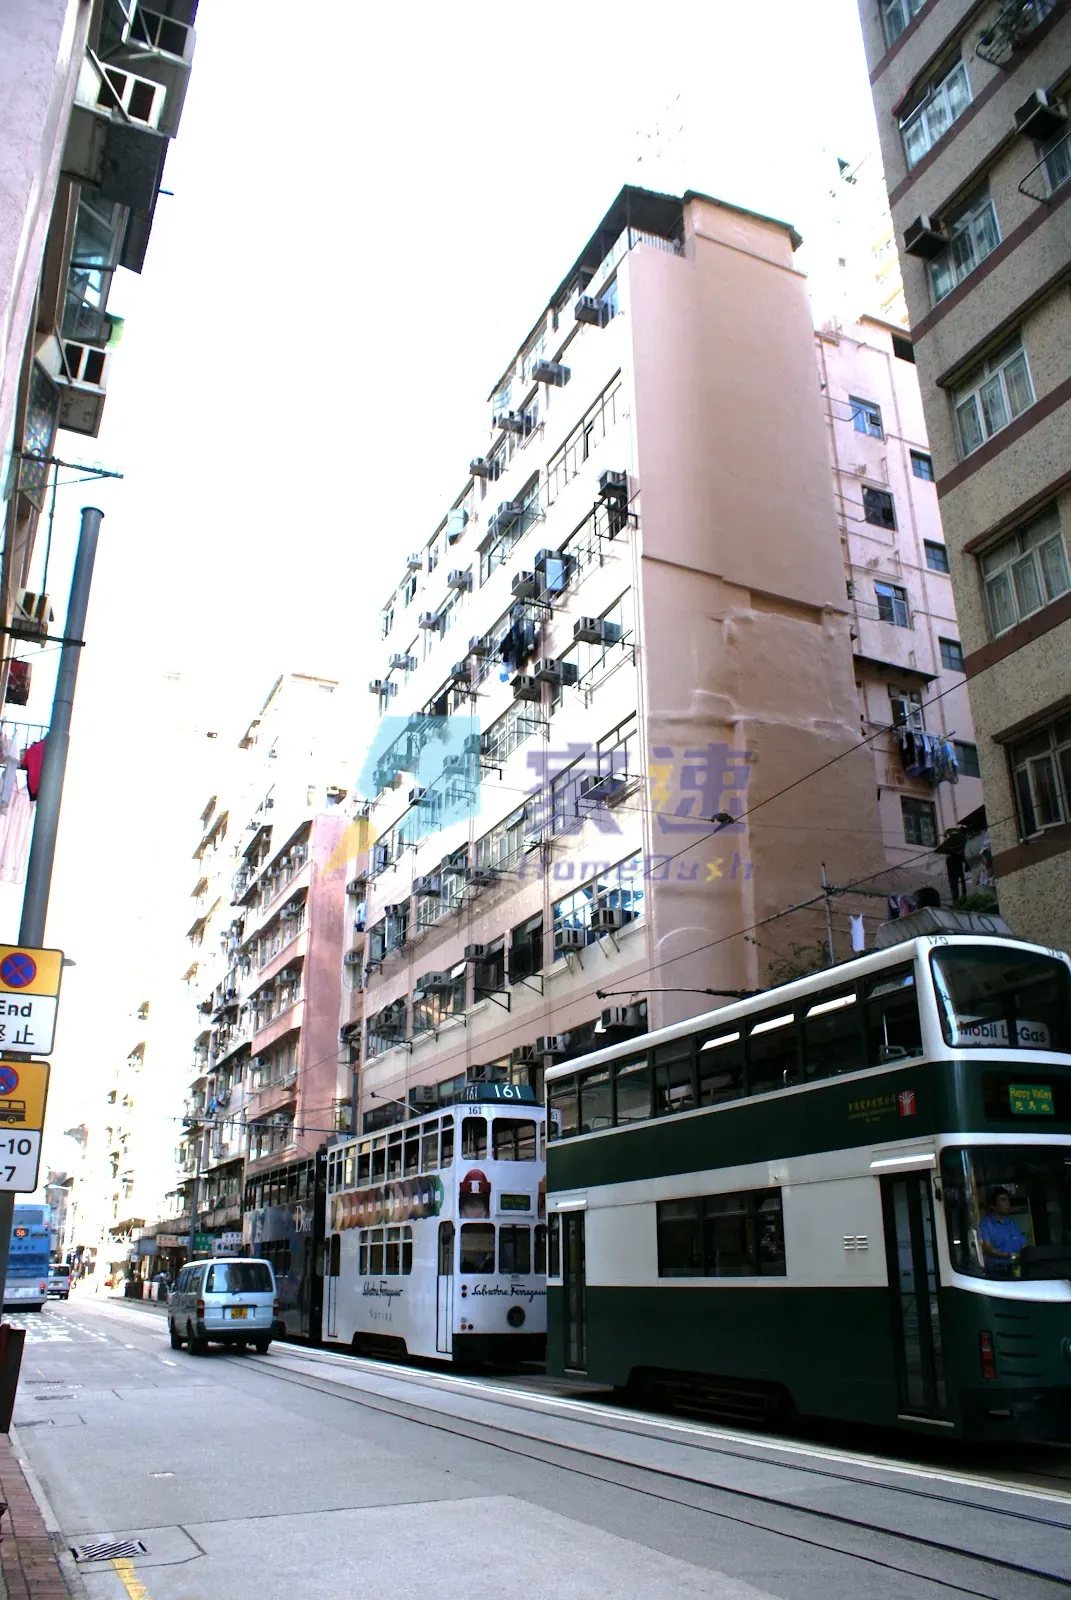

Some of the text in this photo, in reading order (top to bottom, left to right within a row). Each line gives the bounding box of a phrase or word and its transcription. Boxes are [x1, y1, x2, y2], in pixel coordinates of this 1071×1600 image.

[0, 1024, 34, 1045] 止
[1001, 1023, 1047, 1043] L-Gas
[494, 1084, 522, 1099] 161
[1009, 1088, 1053, 1101] Happy Valley
[468, 1106, 482, 1115] 161
[295, 1205, 312, 1233] Dior
[471, 1284, 547, 1303] Salvatore Ferragam
